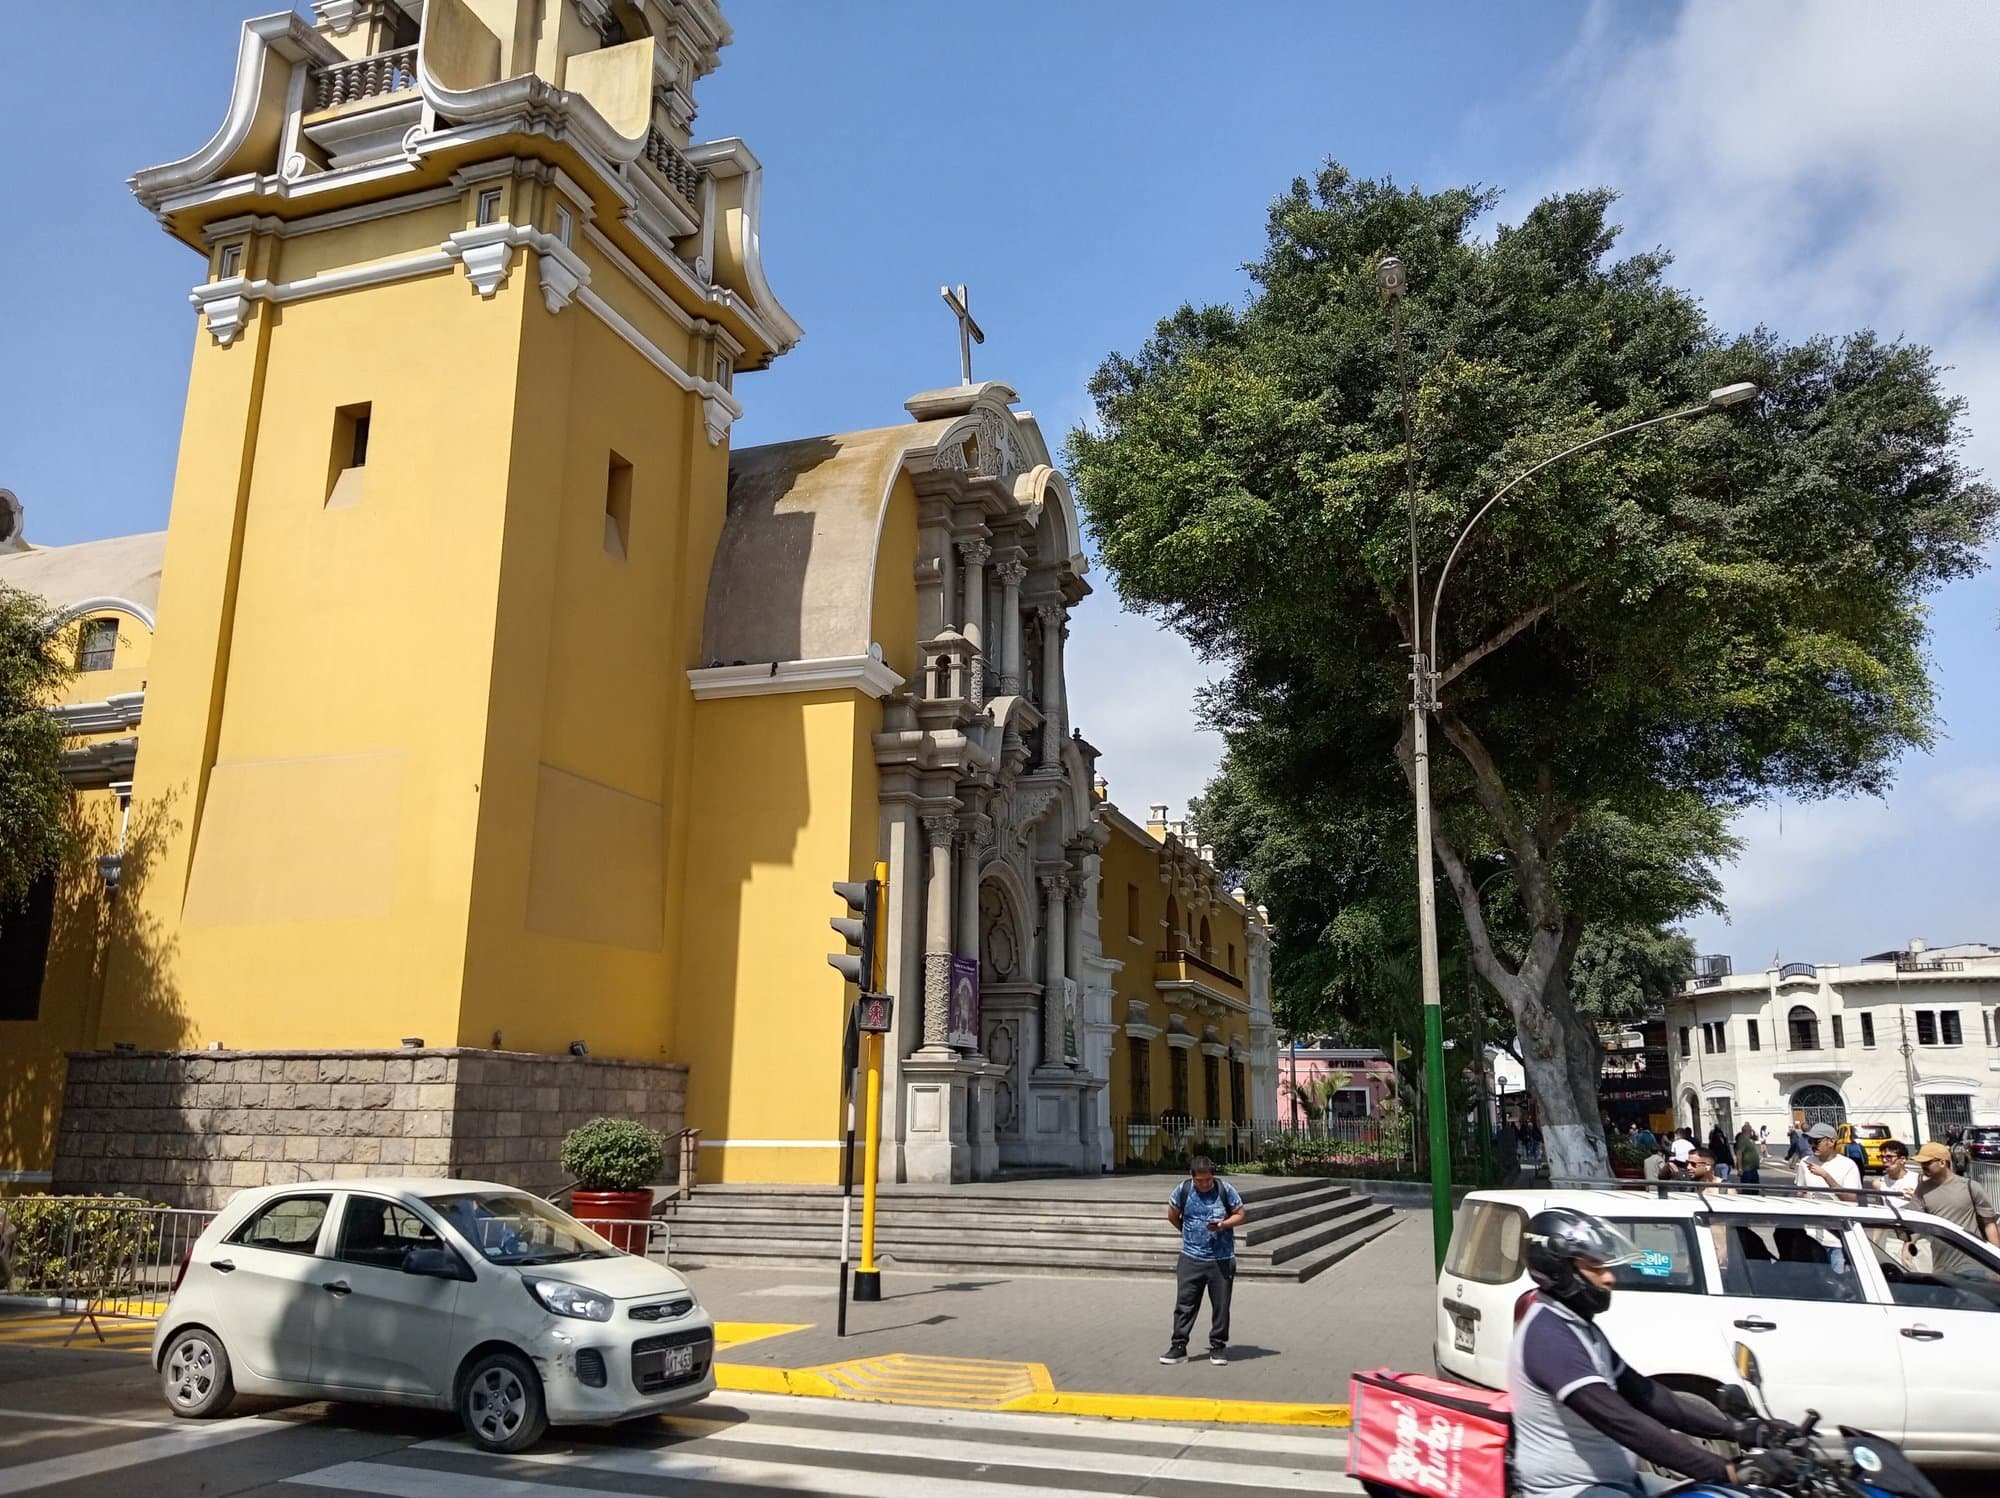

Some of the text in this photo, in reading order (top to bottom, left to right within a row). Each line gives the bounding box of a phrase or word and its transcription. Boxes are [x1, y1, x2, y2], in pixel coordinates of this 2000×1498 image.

[1328, 1060, 1365, 1068] aruma
[1388, 1400, 1424, 1480] Rappi
[1415, 1415, 1450, 1490] Turbo
